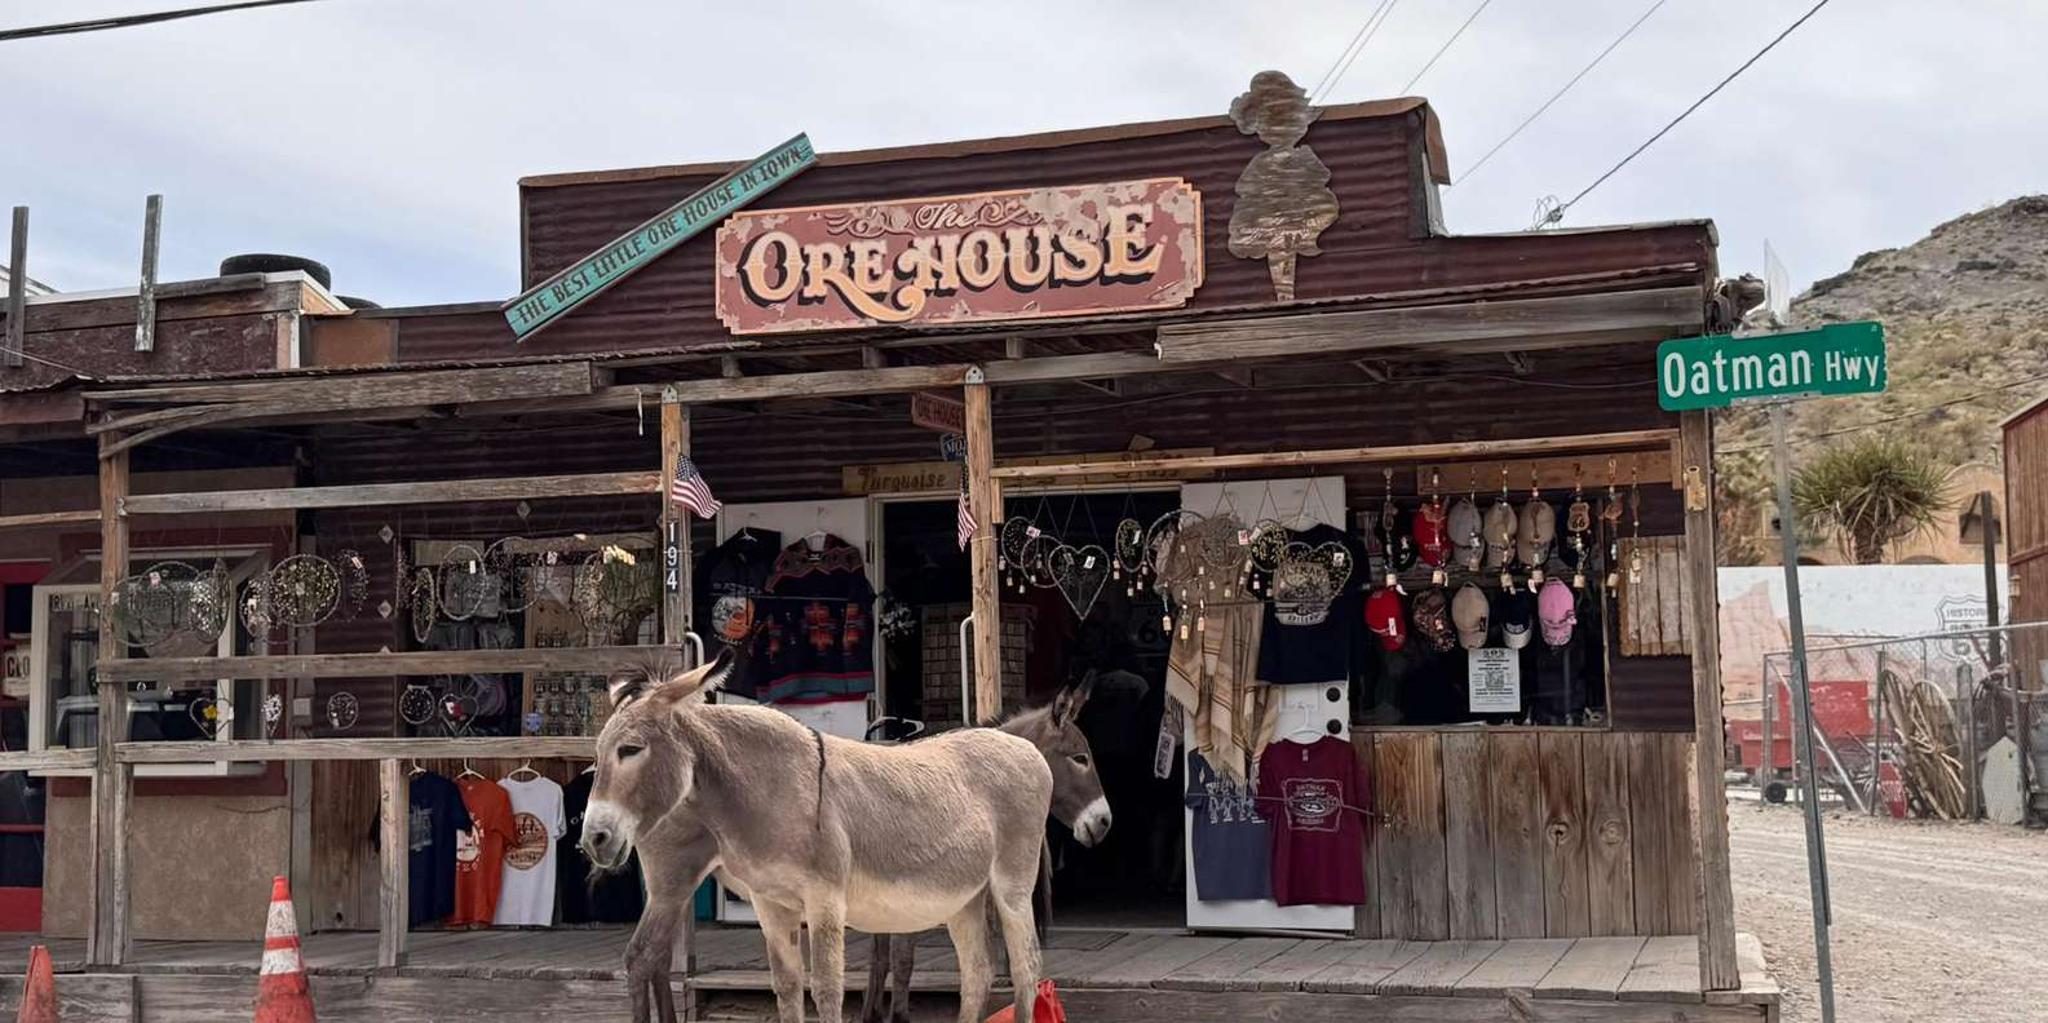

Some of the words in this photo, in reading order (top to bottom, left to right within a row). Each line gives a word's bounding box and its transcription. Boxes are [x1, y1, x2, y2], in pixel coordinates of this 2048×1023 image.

[914, 202, 977, 230] The
[516, 294, 550, 324] THE
[552, 271, 591, 303] BEST
[592, 239, 646, 278] LITTLE
[647, 215, 682, 245] ORE
[682, 183, 738, 226] HOUSE
[739, 172, 758, 193] IN
[758, 147, 802, 181] TOWN
[737, 231, 926, 322] ORE
[894, 203, 1167, 296] HOUSE
[1663, 349, 1812, 398] Oatman
[1824, 350, 1879, 388] Hwy
[857, 466, 947, 492] Turquoise
[666, 522, 679, 590] 194
[1946, 607, 1986, 618] HISTORI
[7, 656, 31, 678] CLO
